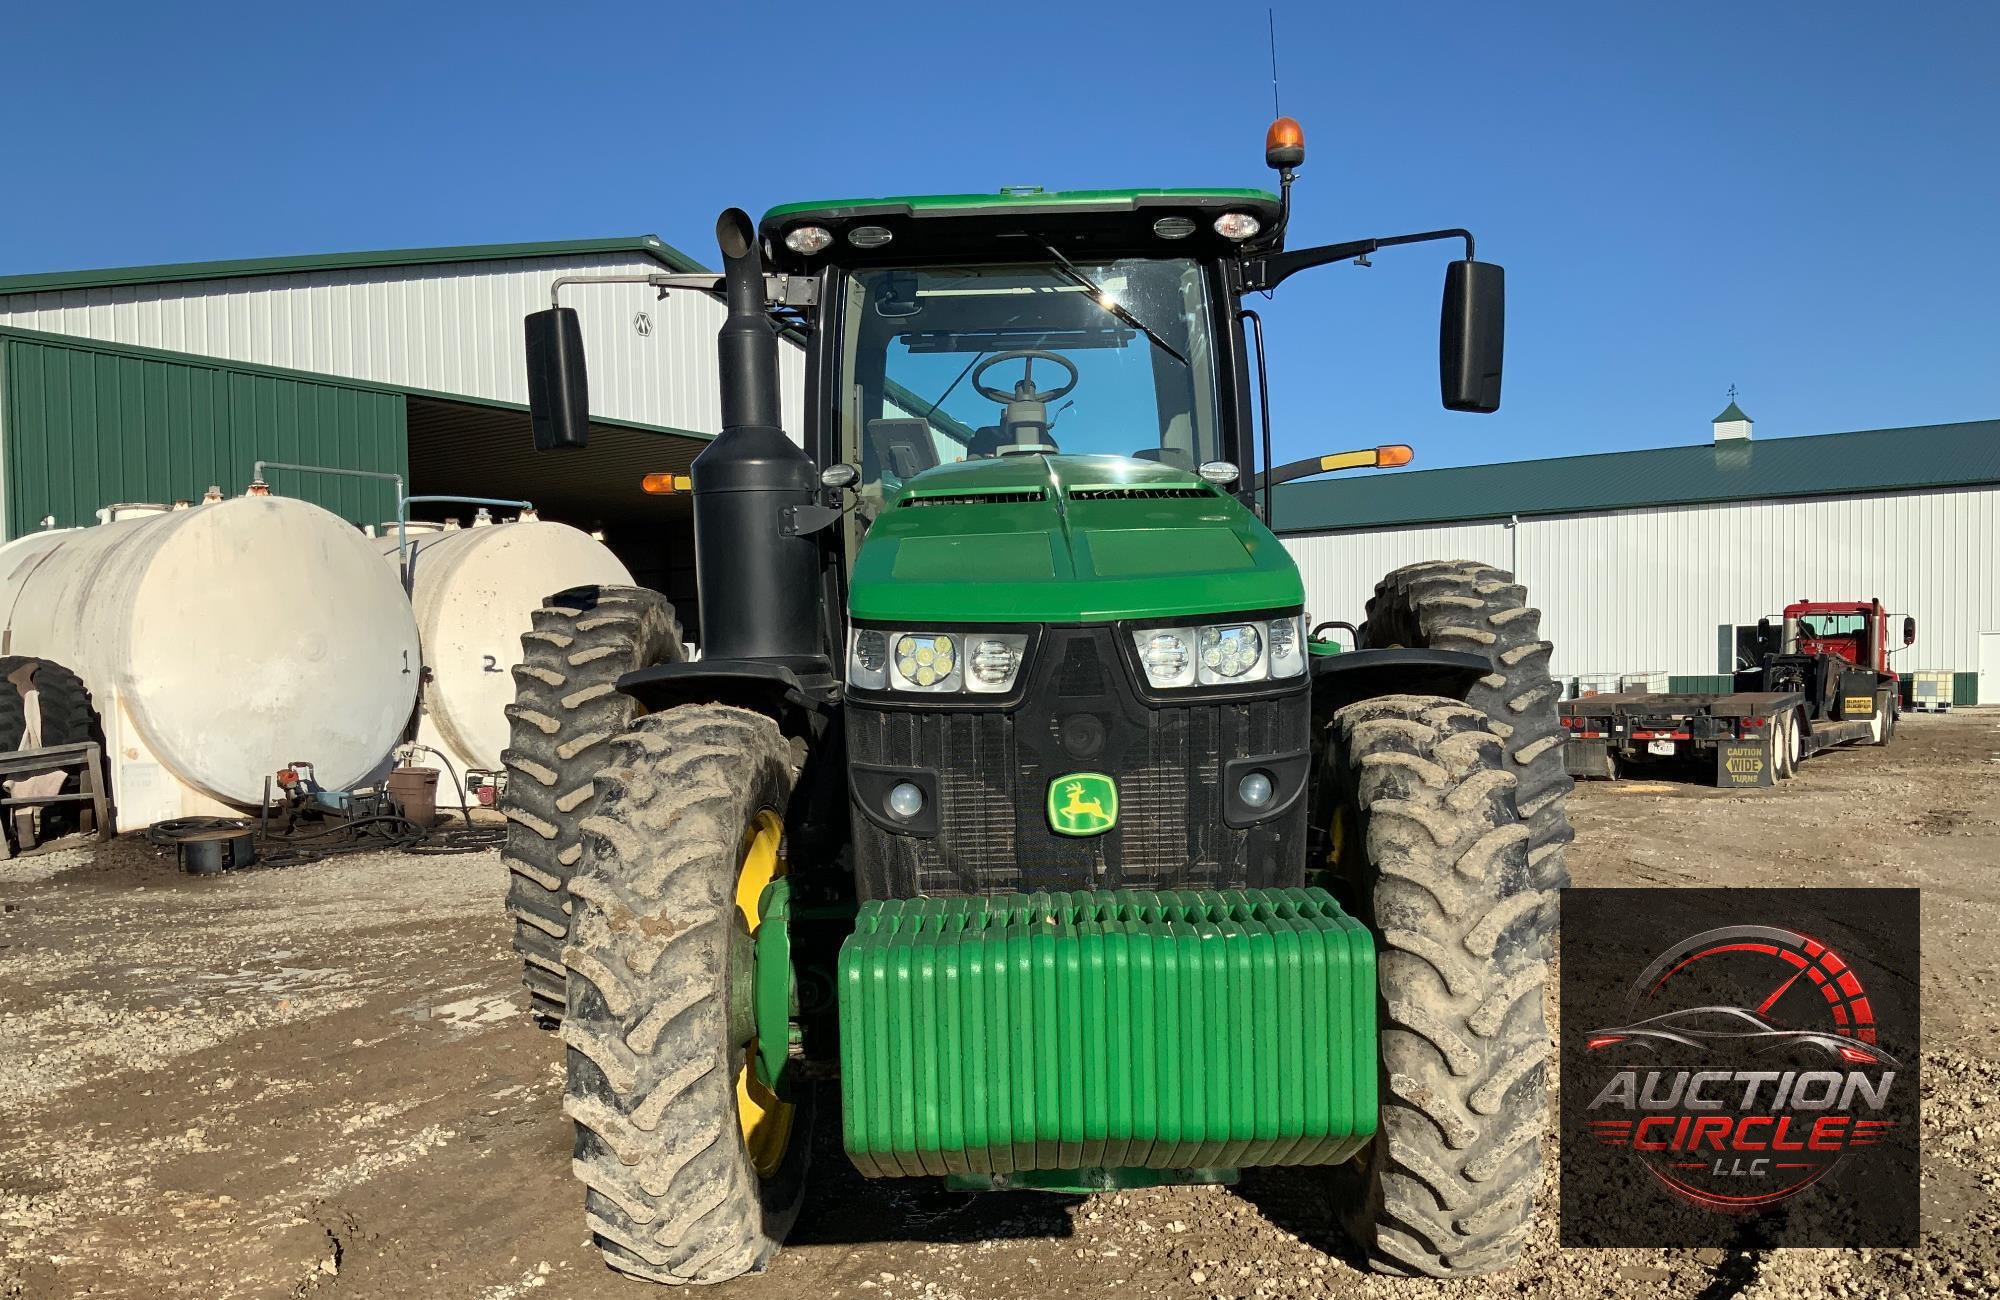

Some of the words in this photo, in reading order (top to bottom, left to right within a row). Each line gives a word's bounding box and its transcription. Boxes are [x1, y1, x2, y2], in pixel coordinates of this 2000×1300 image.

[402, 649, 411, 674] 1
[483, 655, 504, 673] 2
[1727, 747, 1762, 756] CAUTION
[1730, 759, 1759, 772] WIDE
[1731, 774, 1758, 783] TURNS
